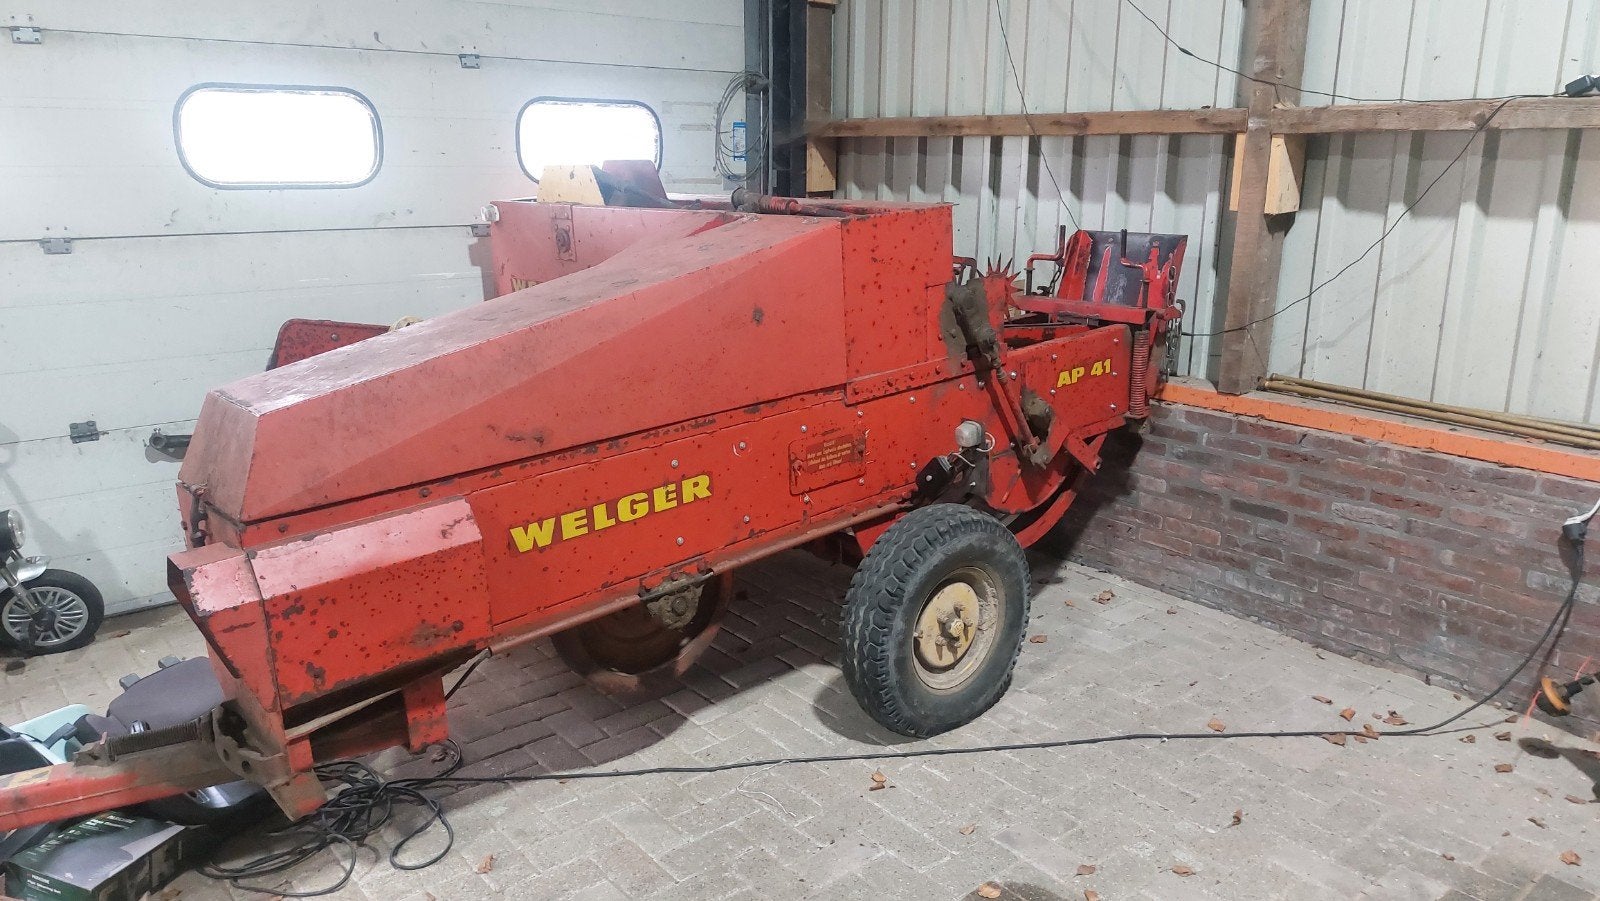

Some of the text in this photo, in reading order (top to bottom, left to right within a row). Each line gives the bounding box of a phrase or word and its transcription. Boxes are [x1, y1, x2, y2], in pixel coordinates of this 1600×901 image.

[1057, 358, 1111, 388] AP 41
[509, 474, 712, 553] WELGER
